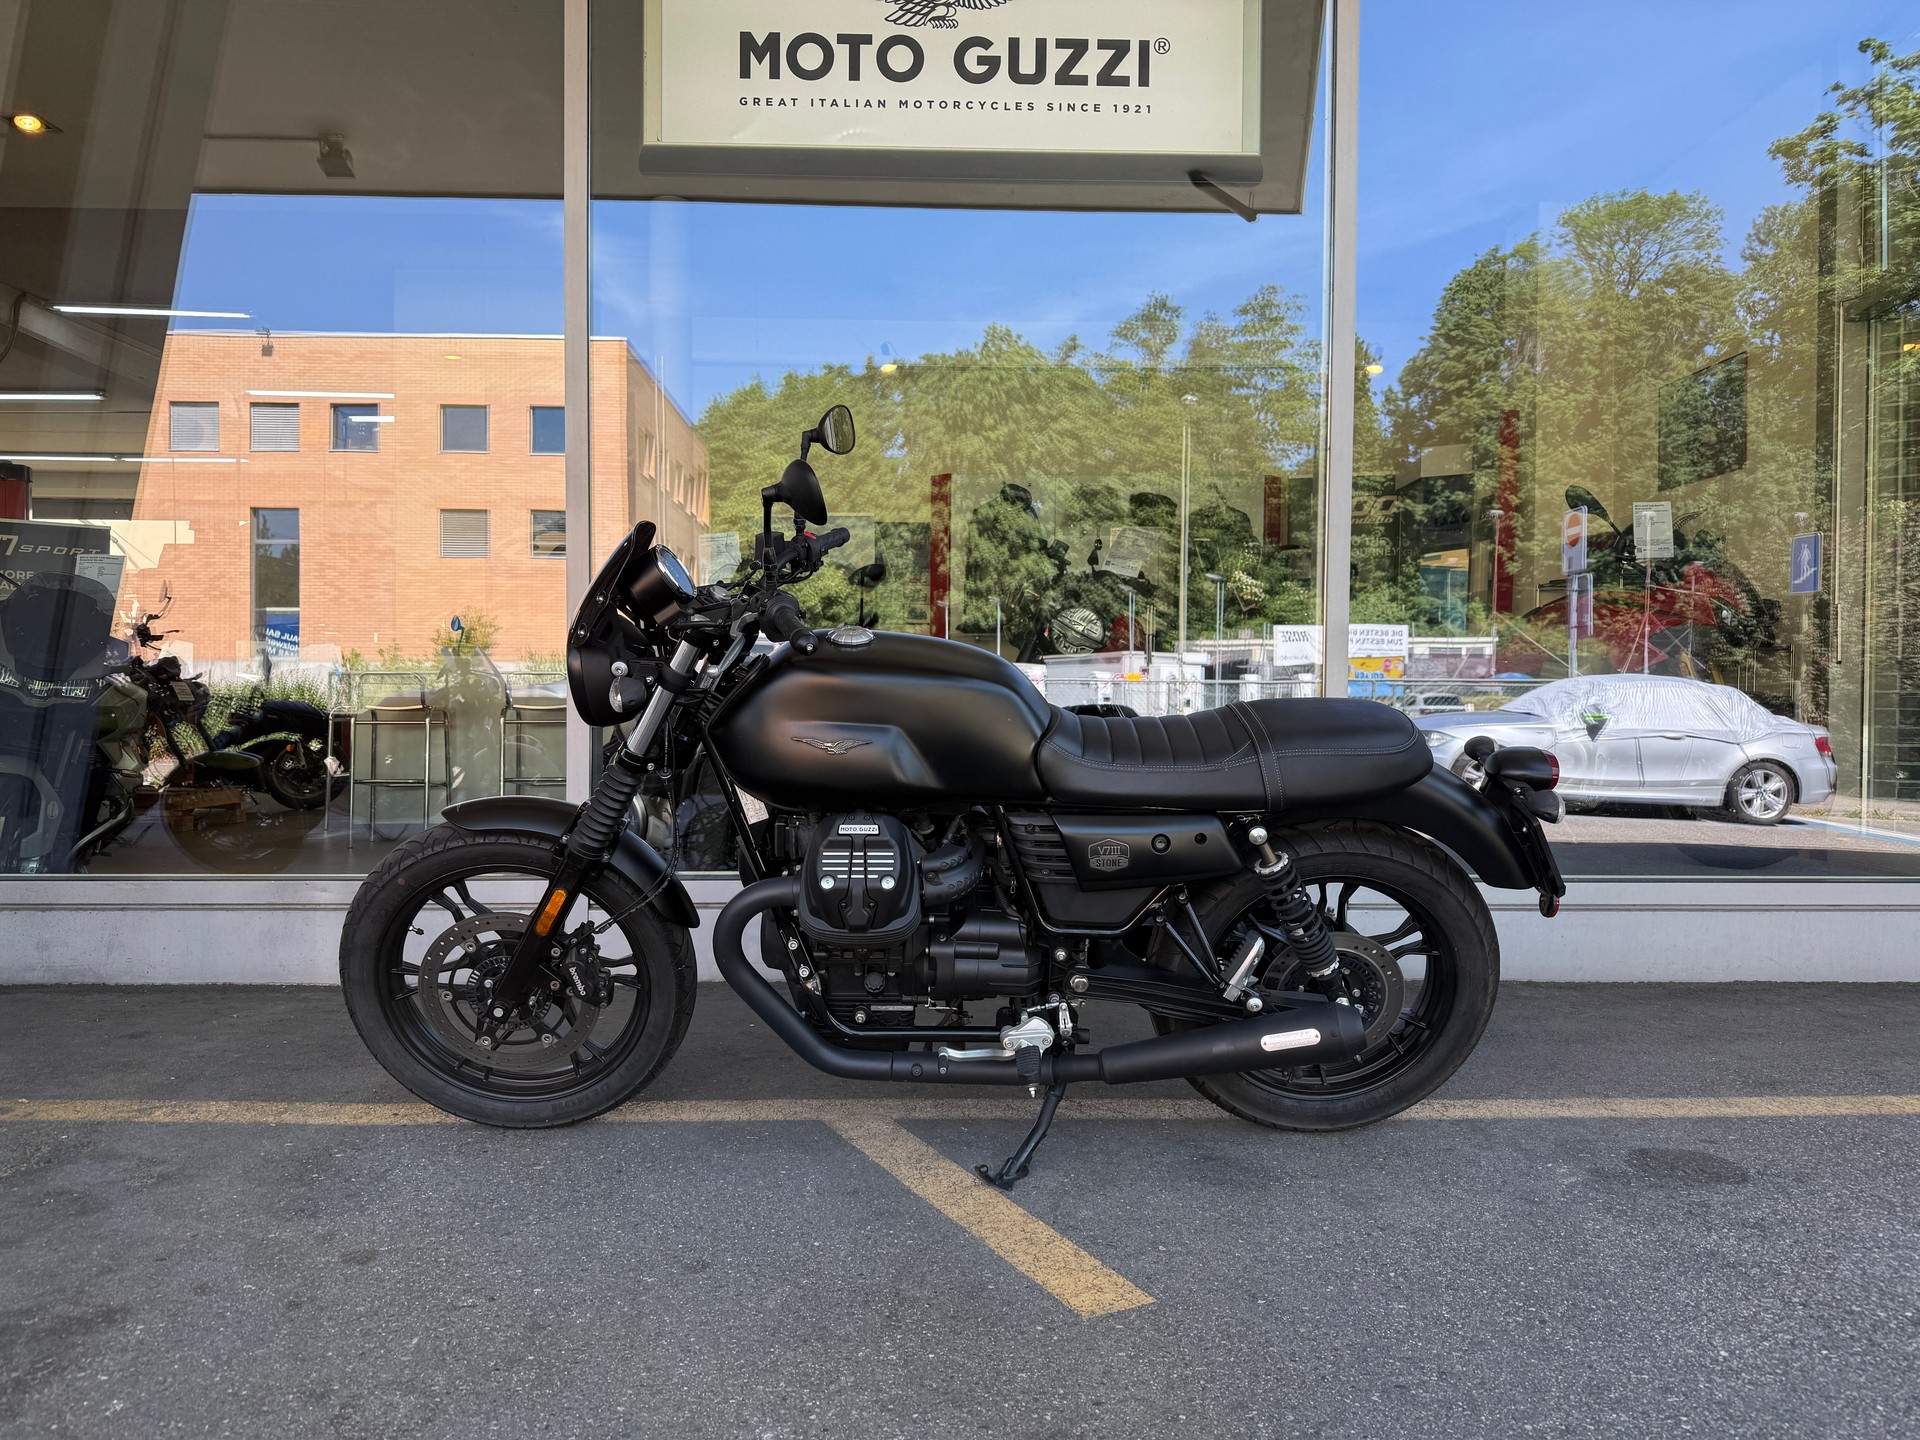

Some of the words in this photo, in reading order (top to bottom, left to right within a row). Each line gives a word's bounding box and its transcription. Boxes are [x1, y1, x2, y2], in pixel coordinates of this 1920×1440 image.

[739, 31, 925, 83] MOTO
[739, 97, 799, 107] GREAT
[810, 98, 887, 109] ITALIAN
[899, 100, 1035, 111] MOTORCYCLES
[1046, 102, 1101, 113] SINCE
[1112, 104, 1151, 114] 1921
[0, 534, 19, 556] 7
[18, 544, 101, 556] SPORT
[0, 569, 35, 581] ORE
[1095, 858, 1123, 868] STONE
[569, 966, 587, 996] brembo
